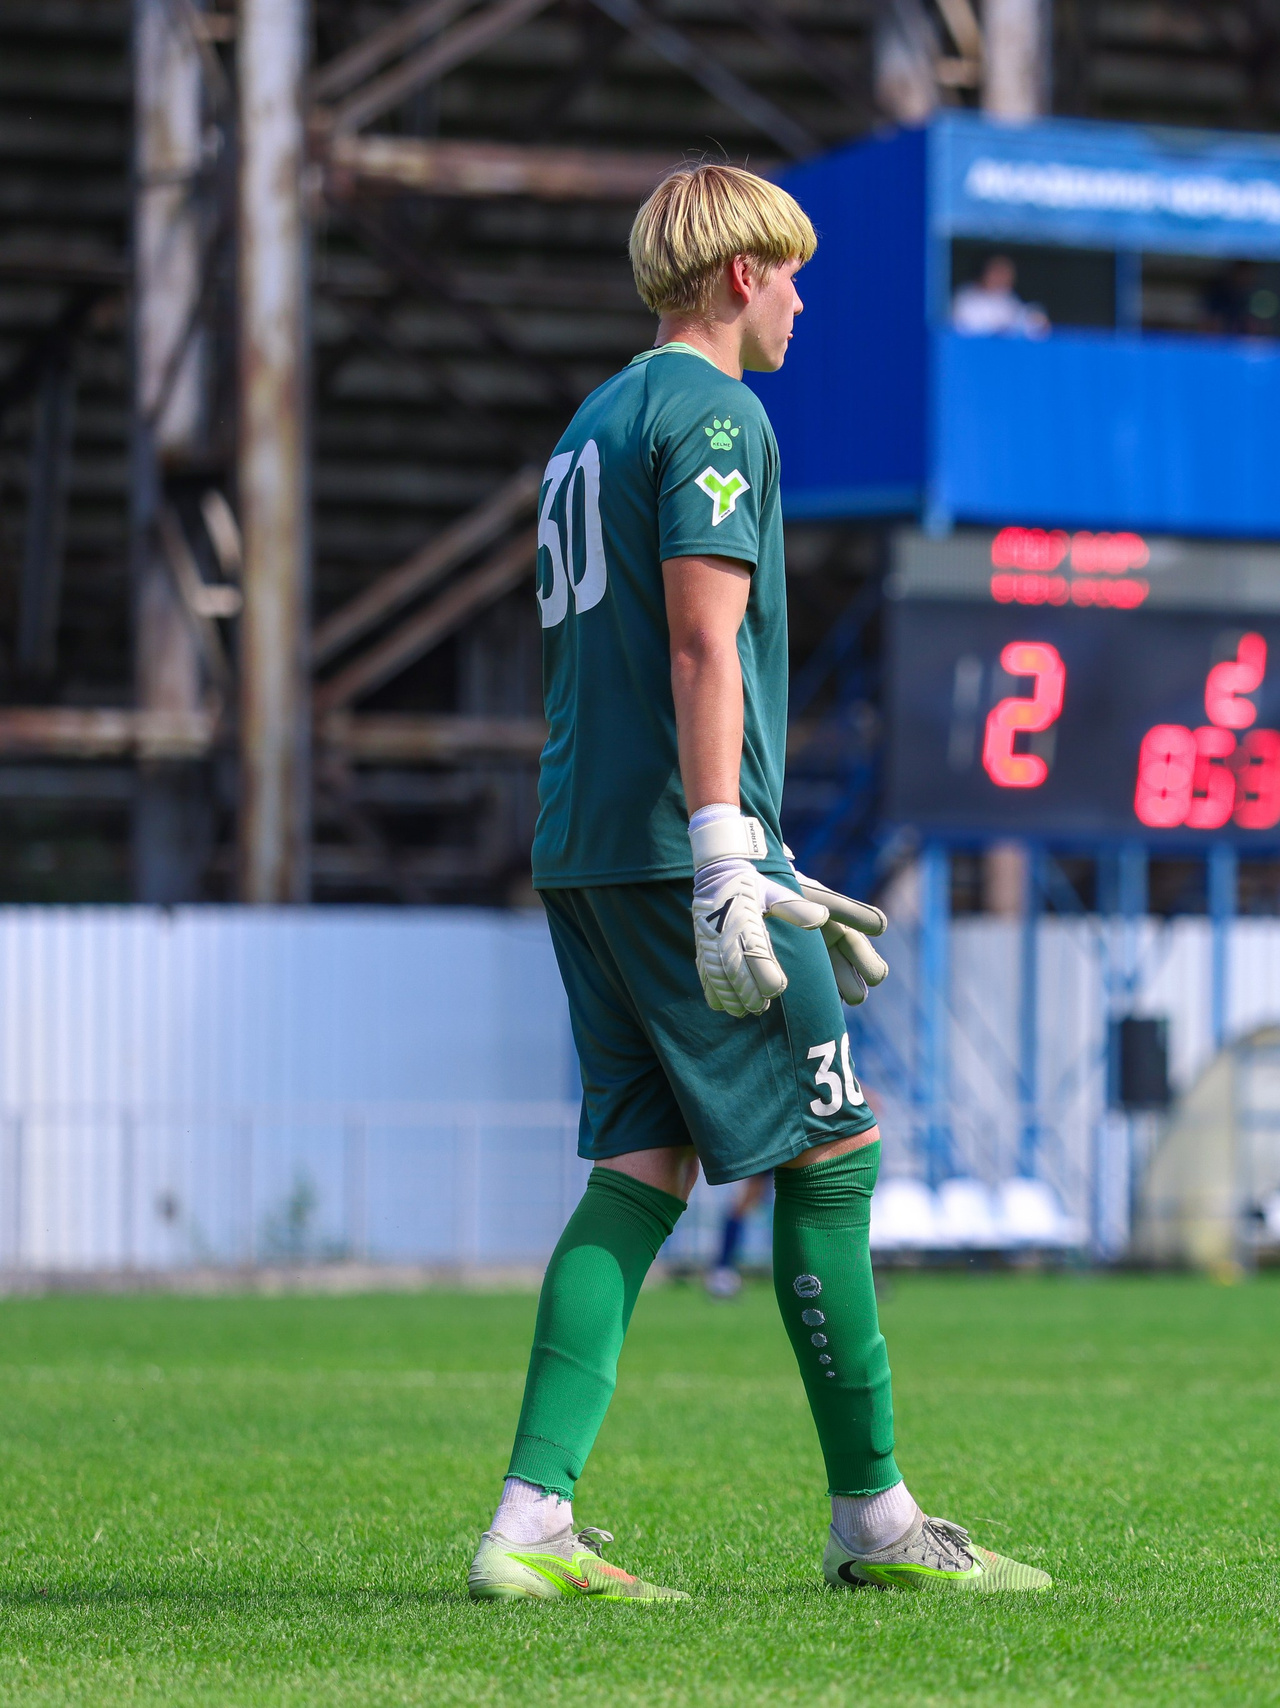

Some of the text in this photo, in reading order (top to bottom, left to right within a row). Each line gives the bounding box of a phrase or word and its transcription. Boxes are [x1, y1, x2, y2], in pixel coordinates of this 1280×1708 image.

[536, 439, 607, 628] 30
[983, 642, 1066, 788] 2
[749, 821, 759, 853] EXTREME
